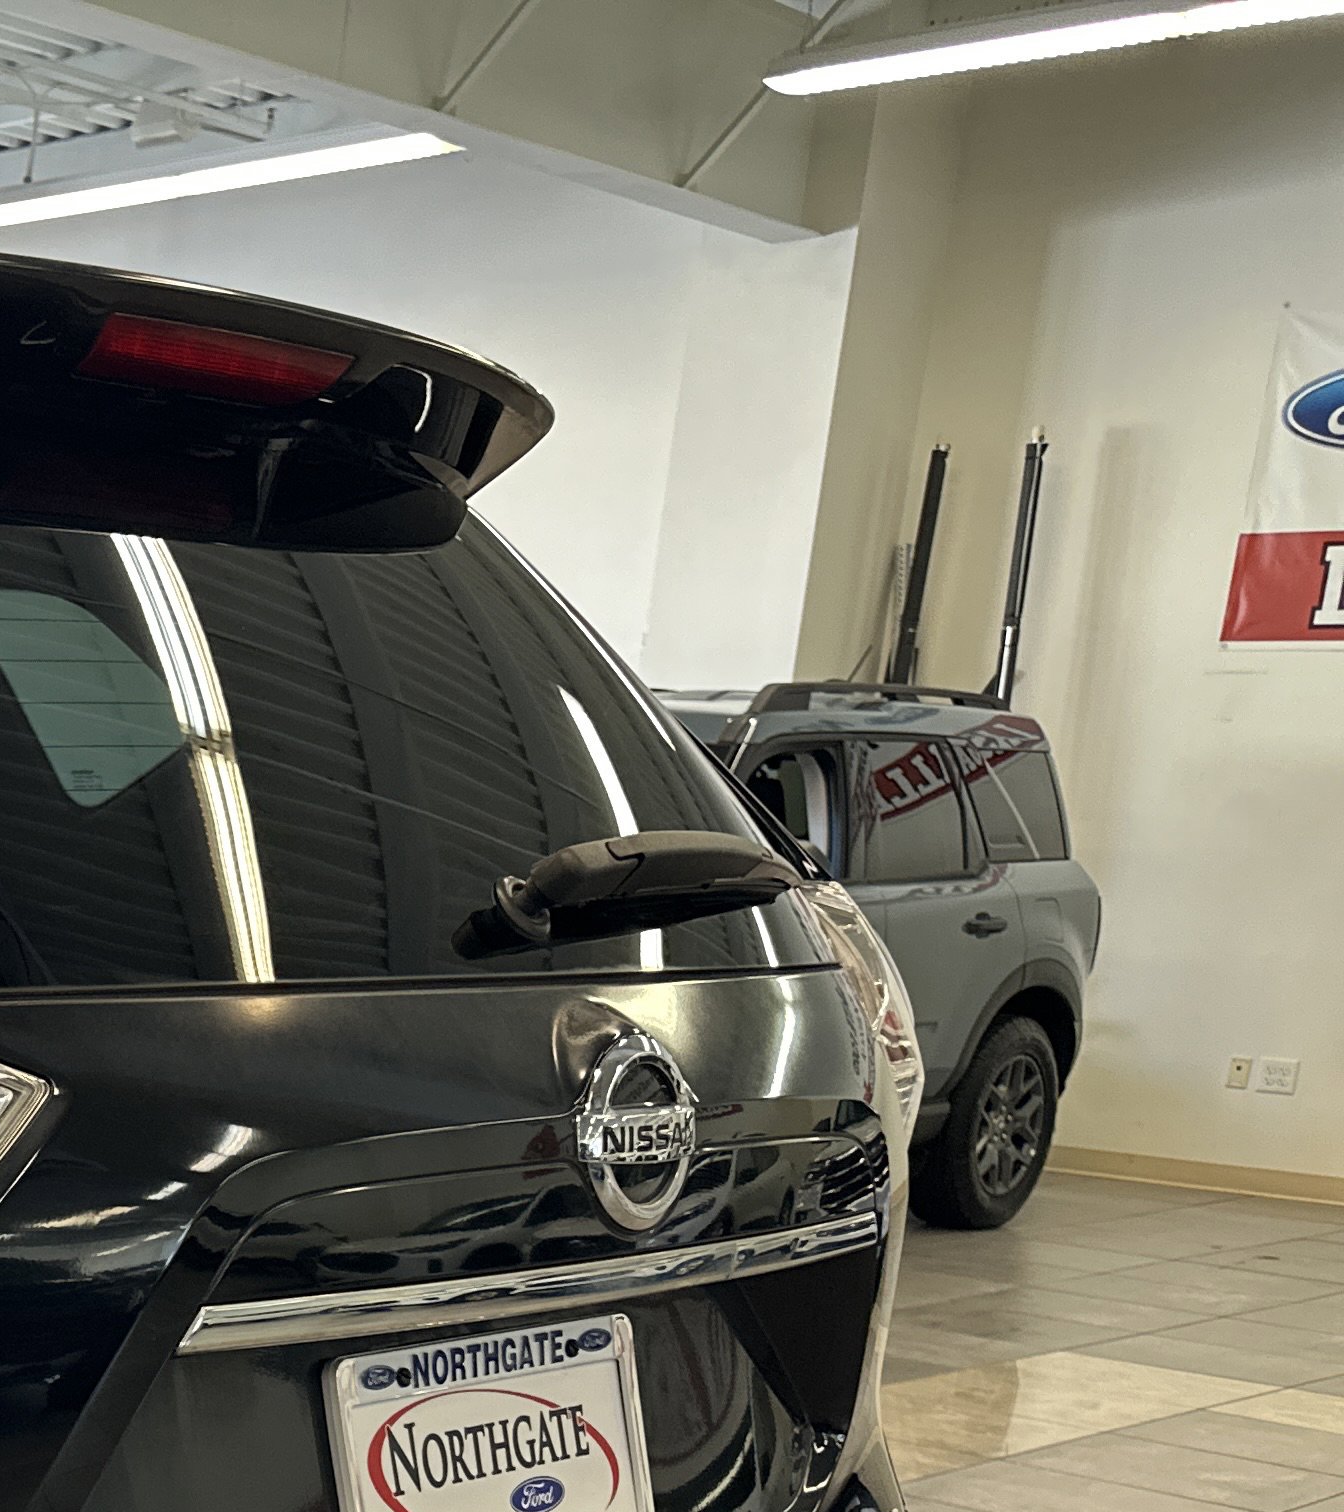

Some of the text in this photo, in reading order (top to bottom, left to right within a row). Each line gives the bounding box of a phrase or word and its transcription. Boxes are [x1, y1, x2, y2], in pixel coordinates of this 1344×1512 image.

[411, 1330, 564, 1388] NORTHGATE
[386, 1404, 590, 1497] NORTHGATE
[520, 1482, 554, 1510] Ford
